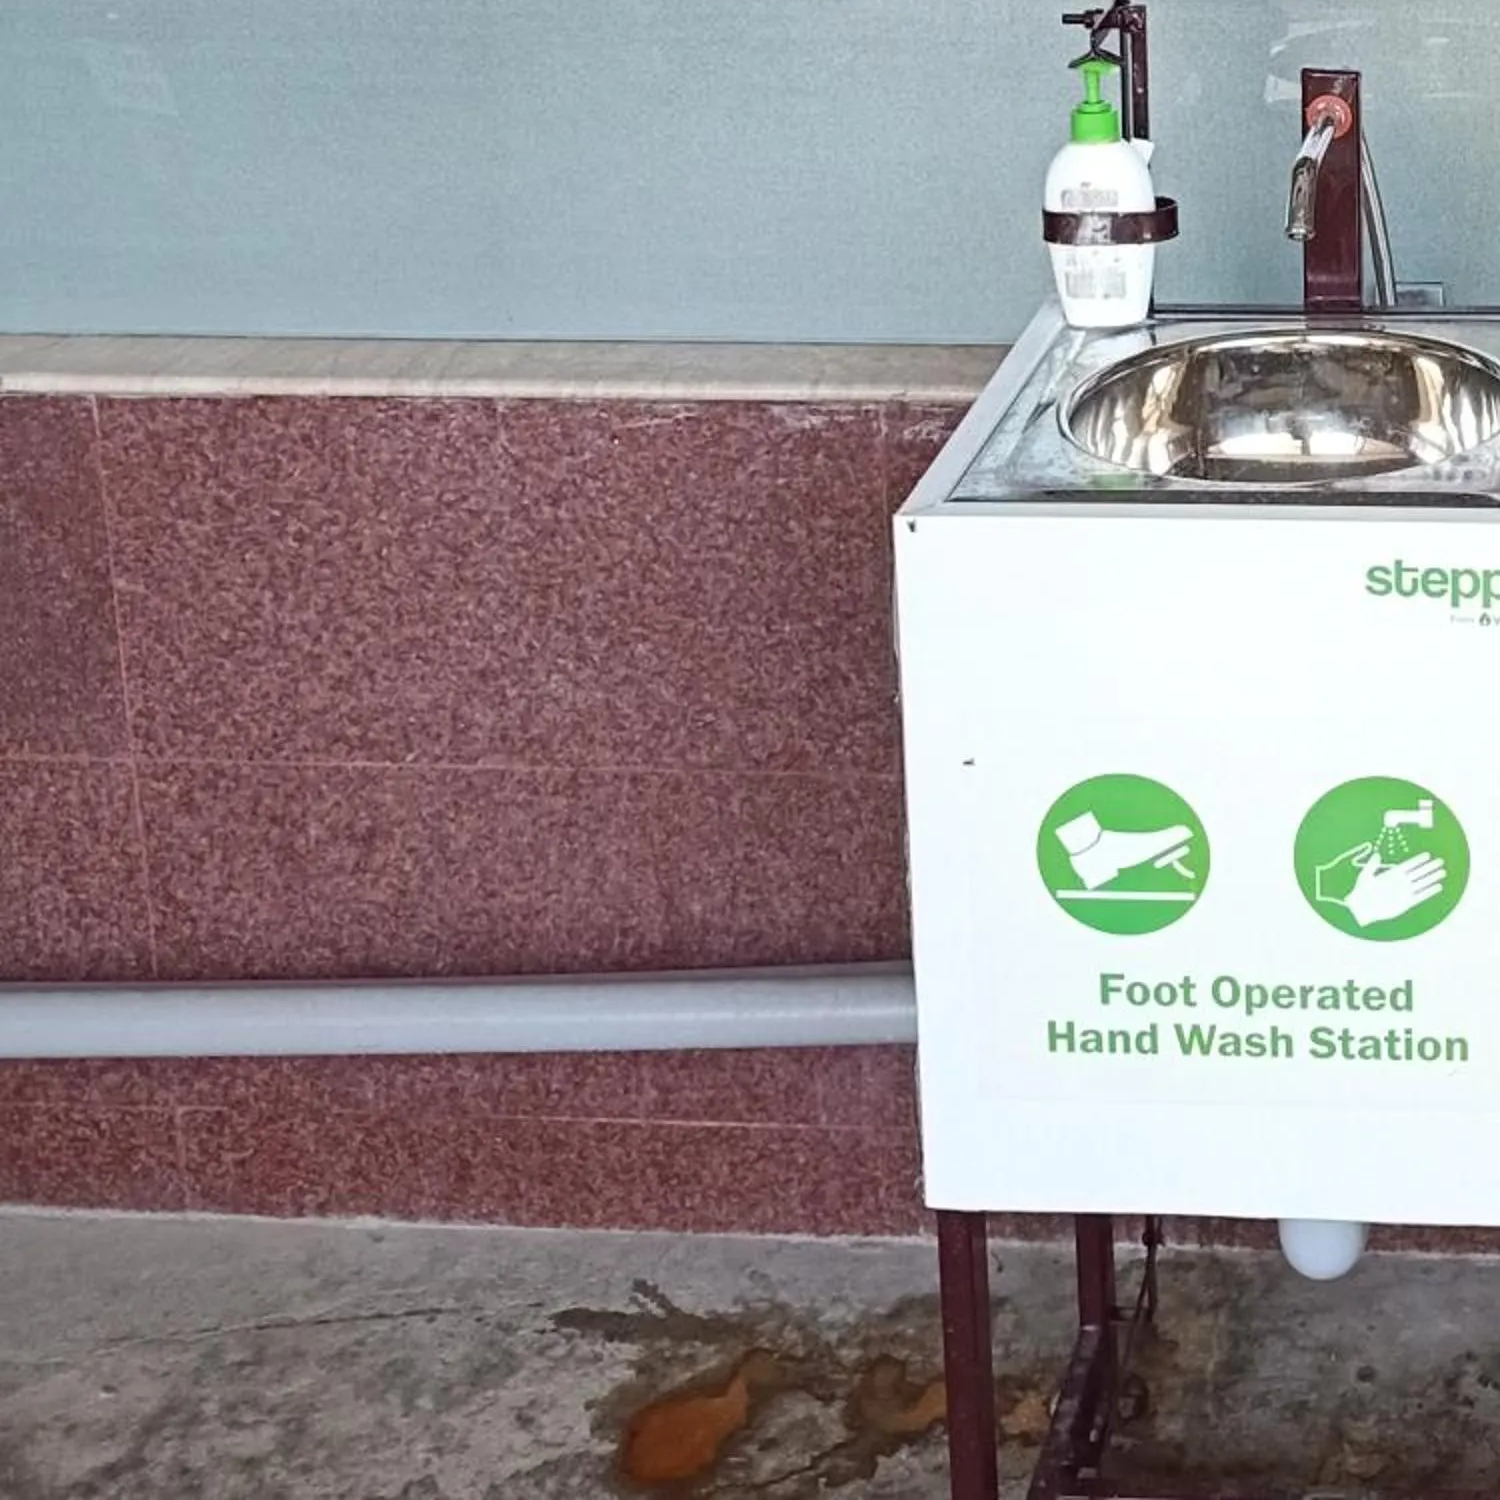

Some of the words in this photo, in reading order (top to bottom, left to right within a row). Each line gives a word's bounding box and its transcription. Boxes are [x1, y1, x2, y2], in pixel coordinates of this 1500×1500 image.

[1099, 972, 1197, 1008] Foot
[1210, 975, 1414, 1016] Operated
[1047, 1019, 1159, 1055] Hand
[1174, 1022, 1294, 1058] Wash
[1308, 1025, 1470, 1062] Station
